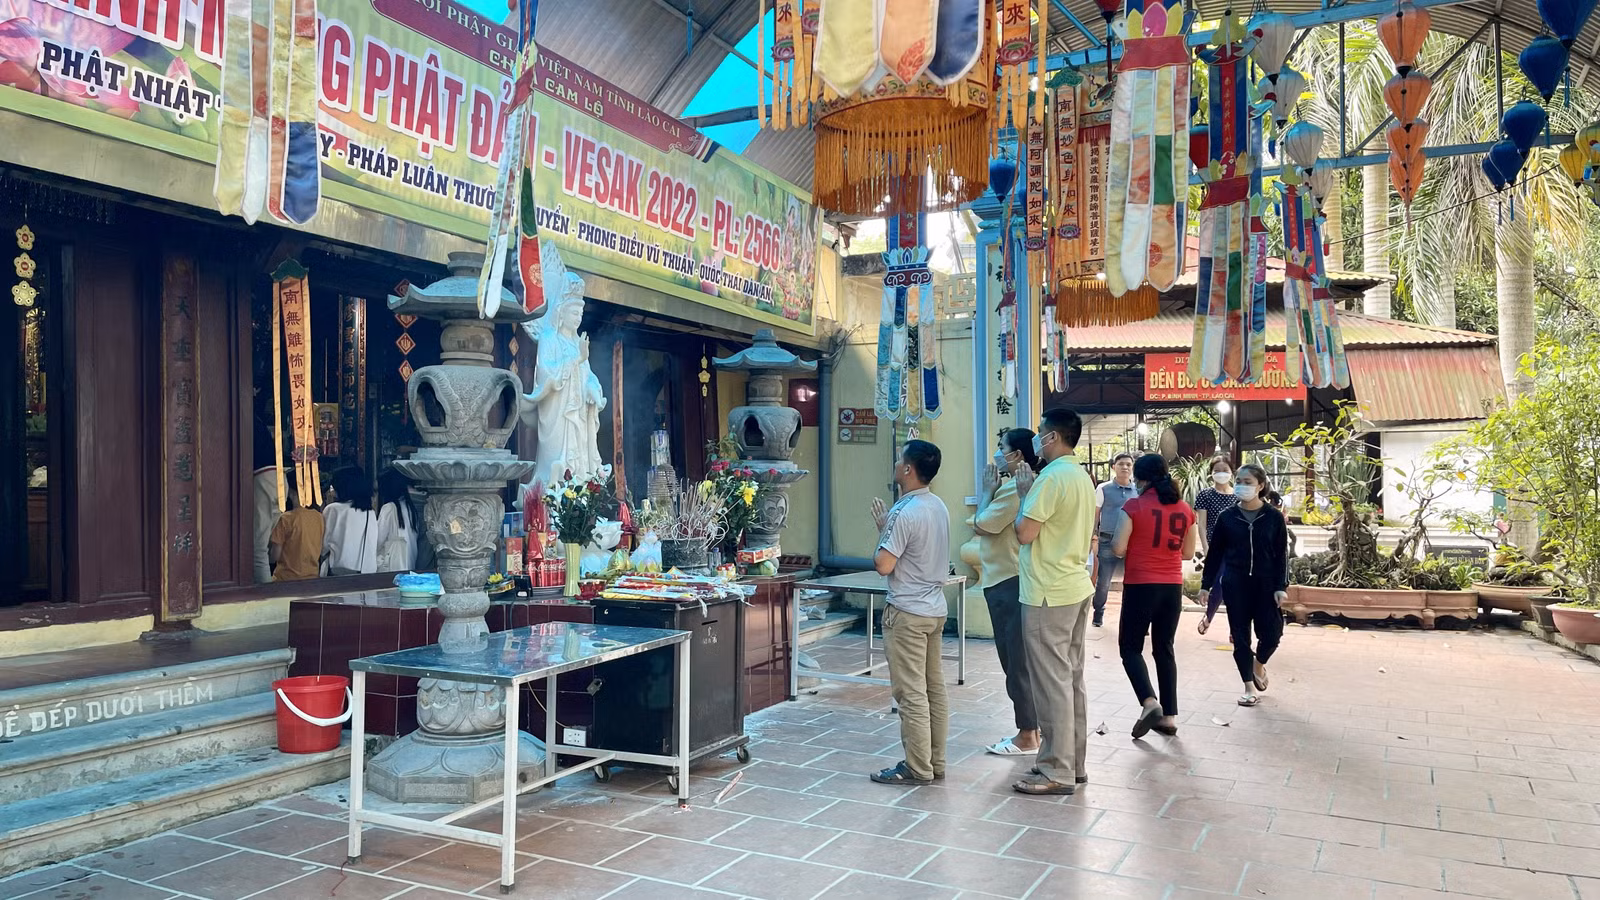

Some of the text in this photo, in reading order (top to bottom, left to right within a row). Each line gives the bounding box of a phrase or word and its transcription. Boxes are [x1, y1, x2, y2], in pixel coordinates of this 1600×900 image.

[447, 5, 491, 39] PHẬT
[538, 54, 571, 80] VIỆT
[574, 73, 604, 97] NAM
[606, 89, 635, 114] TỈNH
[638, 106, 660, 127] LÀO
[663, 121, 681, 138] CAI
[545, 77, 578, 104] CAM
[584, 96, 604, 118] LỘ
[41, 40, 125, 93] PHẬT
[132, 70, 210, 120] NHẬT
[348, 144, 398, 178] PHÁP
[402, 162, 449, 196] LUÂN
[536, 204, 570, 235] UYỂN
[578, 222, 617, 249] PHONG
[619, 231, 644, 259] ĐIỀU
[646, 243, 661, 264] VŨ
[662, 251, 694, 278] THUẬN
[700, 261, 721, 284] QUỐC
[722, 271, 742, 292] THÁI
[743, 278, 759, 297] DÂN
[760, 285, 772, 302] AN
[362, 41, 464, 153] PHẬT
[563, 130, 643, 218] VESAK
[646, 171, 697, 237] 2022
[713, 200, 741, 253] PL:
[743, 214, 780, 271] 2566
[1150, 366, 1175, 389] ĐỀN
[1151, 508, 1188, 551] 19
